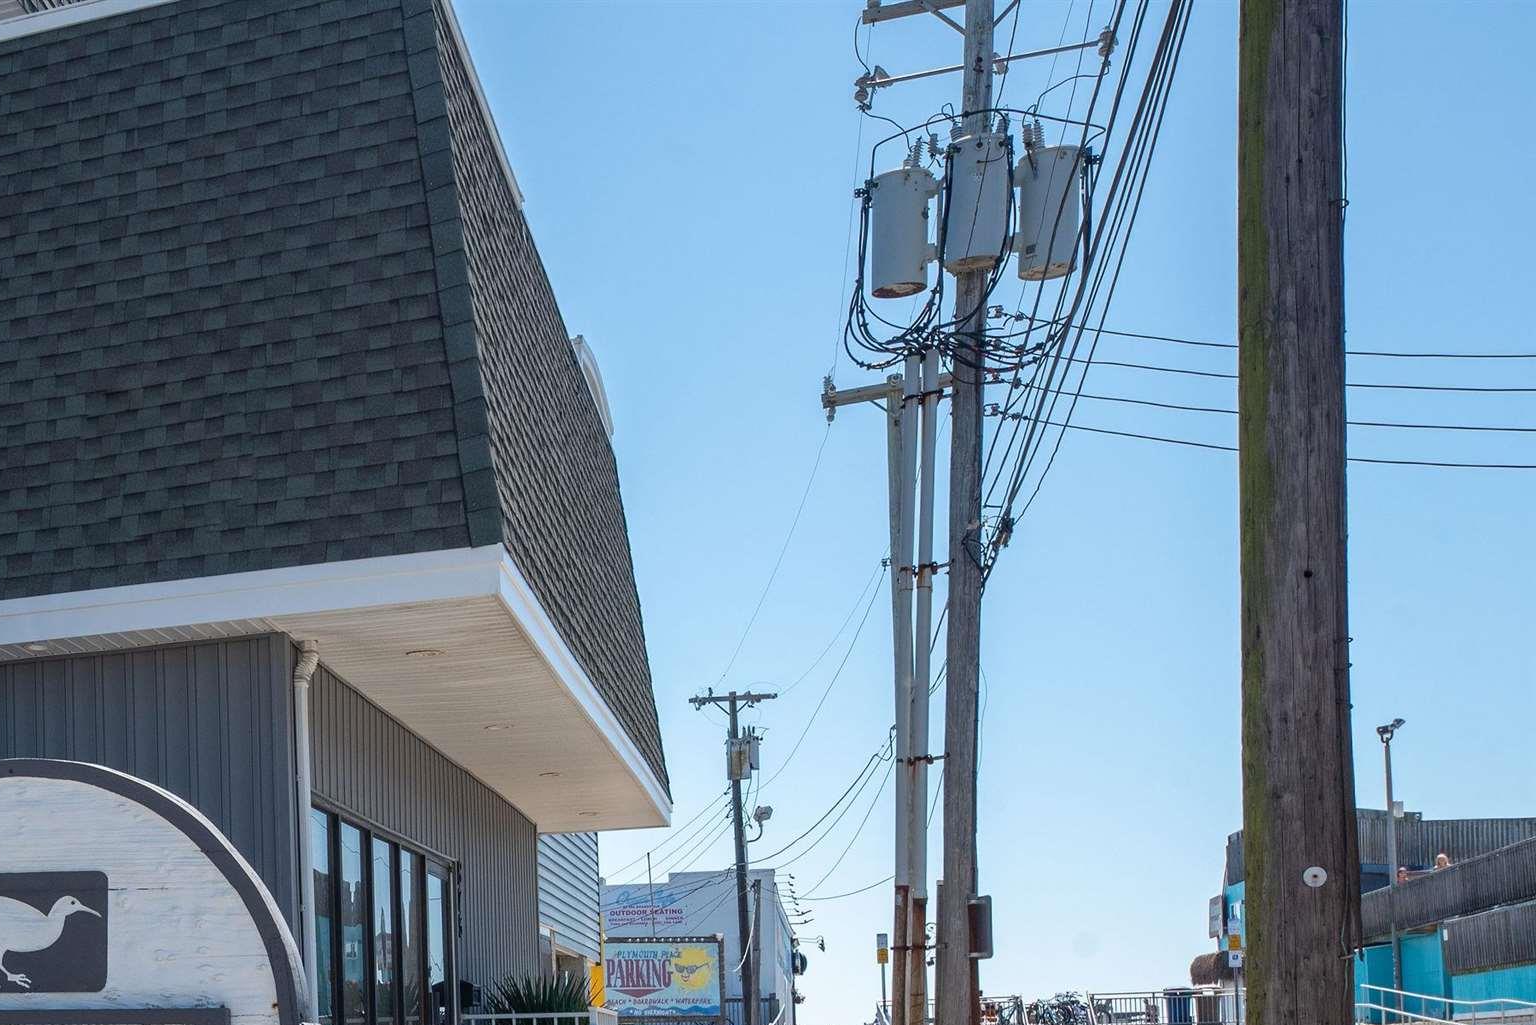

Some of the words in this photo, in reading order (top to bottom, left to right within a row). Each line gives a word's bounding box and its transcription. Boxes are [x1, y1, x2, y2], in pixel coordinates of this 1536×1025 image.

[609, 909, 647, 917] OUTDOOR
[649, 908, 683, 916] SEATING
[617, 950, 658, 959] PLYMOUTH
[605, 958, 674, 988] PARKING
[633, 998, 669, 1006] BOARDWALK
